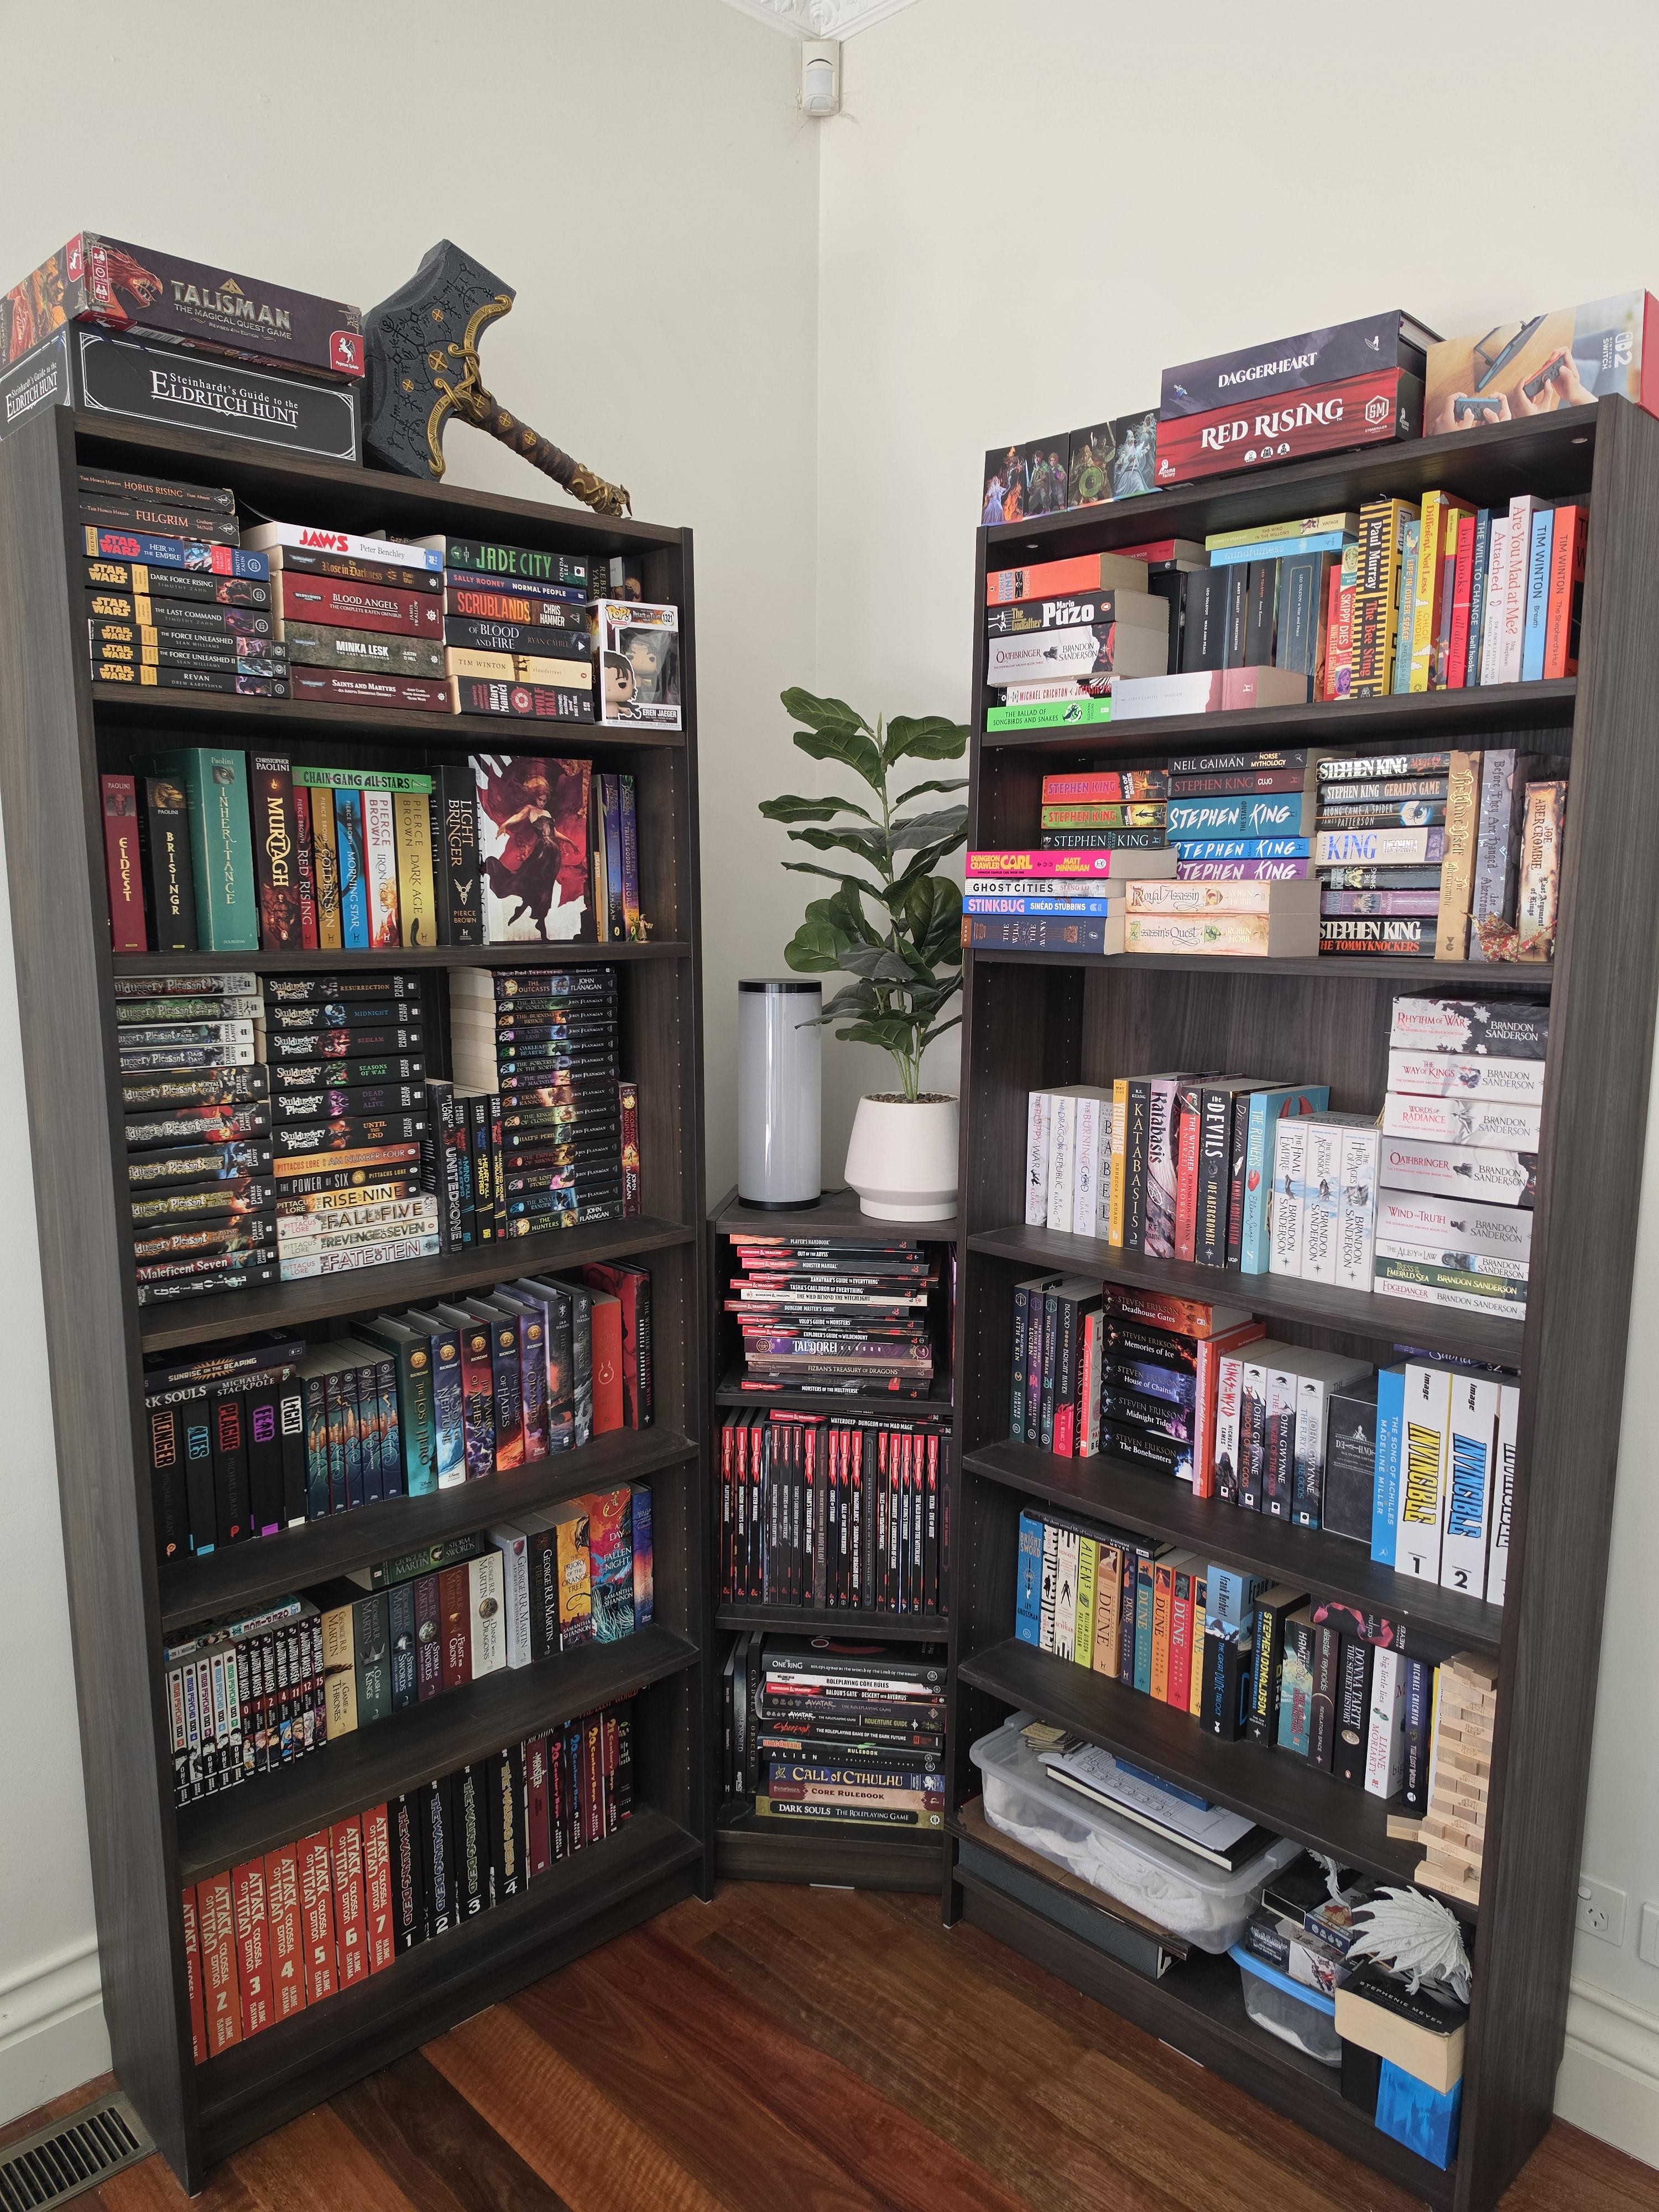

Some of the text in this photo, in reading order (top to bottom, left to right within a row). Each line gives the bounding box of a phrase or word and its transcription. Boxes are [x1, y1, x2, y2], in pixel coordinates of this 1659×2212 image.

[171, 280, 293, 331] TALISMAN
[174, 304, 292, 340] THE MAGICAL QUEST GAME
[1218, 352, 1318, 388] DAGGERHEART
[150, 371, 298, 424] ELDRITCH HUNT
[170, 373, 298, 409] Steinhardt's Guide to the
[1202, 398, 1344, 450] RED RISING
[124, 482, 183, 497] HORUS RISING
[136, 510, 189, 528] FULGRIM
[299, 530, 348, 552] JAWS
[1537, 525, 1546, 547] TIM
[476, 547, 551, 578] JADE CITY
[1364, 521, 1382, 589] Paul Murray
[453, 575, 505, 588] SALLY ROONEY
[1533, 549, 1545, 598] WINTON
[512, 583, 566, 597] NORMAL PEOPLE
[457, 592, 531, 622] SCRUBLANDS
[543, 603, 561, 616] CHRIS
[1011, 608, 1024, 619] The
[540, 614, 565, 627] HAMMER
[1011, 617, 1042, 632] Godfather
[336, 640, 389, 656] MINKA LESK
[996, 648, 1041, 662] OATHBRINGER
[1060, 649, 1098, 661] SANDERSON
[1062, 643, 1094, 653] BRANDON
[184, 672, 210, 681] REVAN
[643, 708, 677, 717] EREN JAEGER
[993, 714, 1058, 726] SONGBIRDS AND SNAKES
[1173, 757, 1244, 771] NEIL GAIMAN
[1251, 759, 1286, 768] MYTHOLOGY
[1327, 785, 1379, 799] STEPHEN KING
[1384, 781, 1439, 797] GERALD'S GAME
[1323, 807, 1343, 816] ALONG
[1345, 806, 1362, 816] CAME
[1371, 804, 1393, 814] SPIDER
[461, 800, 473, 847] LIGHT
[266, 796, 290, 887] MURTAGH
[445, 799, 462, 867] BRINGER
[218, 787, 236, 905] INHERITANCE
[118, 837, 132, 901] ELDEST
[166, 831, 180, 915] BRISINGR
[973, 883, 1053, 892] GHOST CITIES
[968, 899, 1025, 912] STINKBUG
[1030, 902, 1052, 910] SINÉAD
[1335, 941, 1420, 952] TOMMYKNOCKERS
[1485, 1029, 1538, 1041] SANDERSON
[1490, 1020, 1534, 1032] BRANDON
[1150, 1092, 1168, 1164] Katabasis
[1206, 1103, 1225, 1159] DEVILS
[328, 1156, 343, 1166] AM
[345, 1152, 380, 1164] NUMBER
[383, 1149, 404, 1159] FOUR
[1131, 1103, 1143, 1228] KATABASIS
[531, 1221, 559, 1230] HUNTERS
[140, 1258, 228, 1280] Maleficent Seven
[1121, 1305, 1175, 1323] Deadhouse Gates
[168, 1369, 201, 1381] SUNRISE
[224, 1358, 257, 1369] REAPING
[1126, 1409, 1172, 1429] Midnight Tides
[152, 1411, 175, 1468] HUNGER
[1120, 1442, 1172, 1464] The Bonehunters
[1390, 1465, 1396, 1477] OF
[1403, 1421, 1441, 1527] INVINCIBLE
[1448, 1432, 1486, 1539] INVINCIBLE
[1387, 1479, 1396, 1526] ACHILLES
[1020, 1532, 1041, 1548] BRIGHT
[603, 1547, 632, 1561] FALLEN
[1020, 1542, 1040, 1558] SWORD
[564, 1559, 585, 1571] PRIORY
[605, 1558, 630, 1570] NIGHT
[1413, 1557, 1420, 1574] 1
[562, 1572, 588, 1586] ORANGE
[568, 1583, 583, 1593] TREE
[1454, 1570, 1468, 1589] 2
[1218, 1575, 1230, 1617] Frank Herbert
[1097, 1592, 1112, 1646] DUNE
[1381, 1656, 1390, 1667] big
[1351, 1646, 1365, 1729] DONNA TARTT
[332, 1679, 341, 1723] THRONES
[1369, 1723, 1379, 1775] MORIARTY
[1378, 1736, 1388, 1770] LIANE
[792, 1767, 902, 1786] CALL of CTHULHU
[838, 1790, 884, 1799] RULEBOOK
[779, 1804, 831, 1814] DARK SOULS
[376, 1817, 388, 1867] ATTACK
[377, 1914, 386, 1933] 7
[1359, 1981, 1443, 2025] STEPHENIE MEYER
